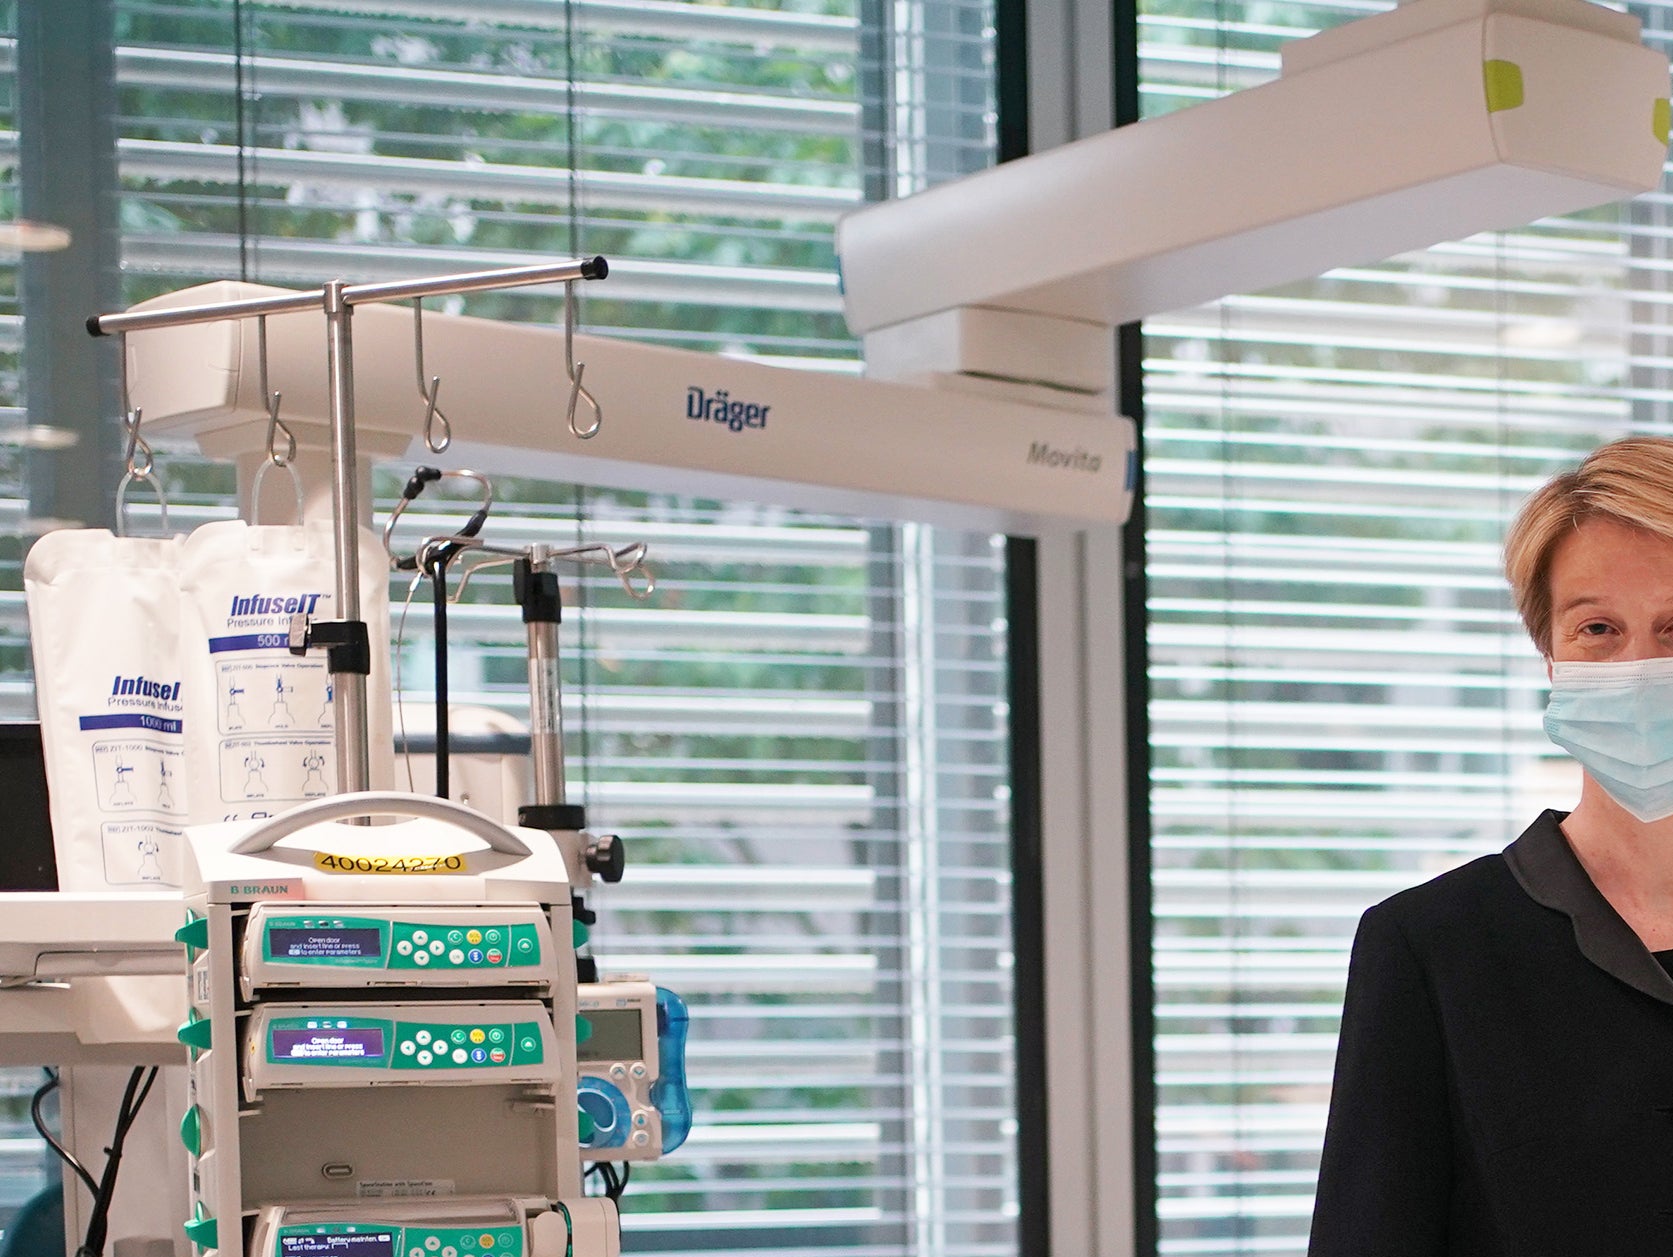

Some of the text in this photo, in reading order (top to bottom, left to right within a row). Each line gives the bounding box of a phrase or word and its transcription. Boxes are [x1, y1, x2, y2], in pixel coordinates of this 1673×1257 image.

[686, 386, 772, 432] Dräger
[1027, 441, 1102, 472] Movita
[227, 616, 275, 628] Pressure
[257, 634, 280, 647] 500
[112, 675, 182, 701] InfuseI
[163, 721, 177, 732] ml
[320, 855, 461, 873] 40024270
[243, 884, 288, 895] BRAUN
